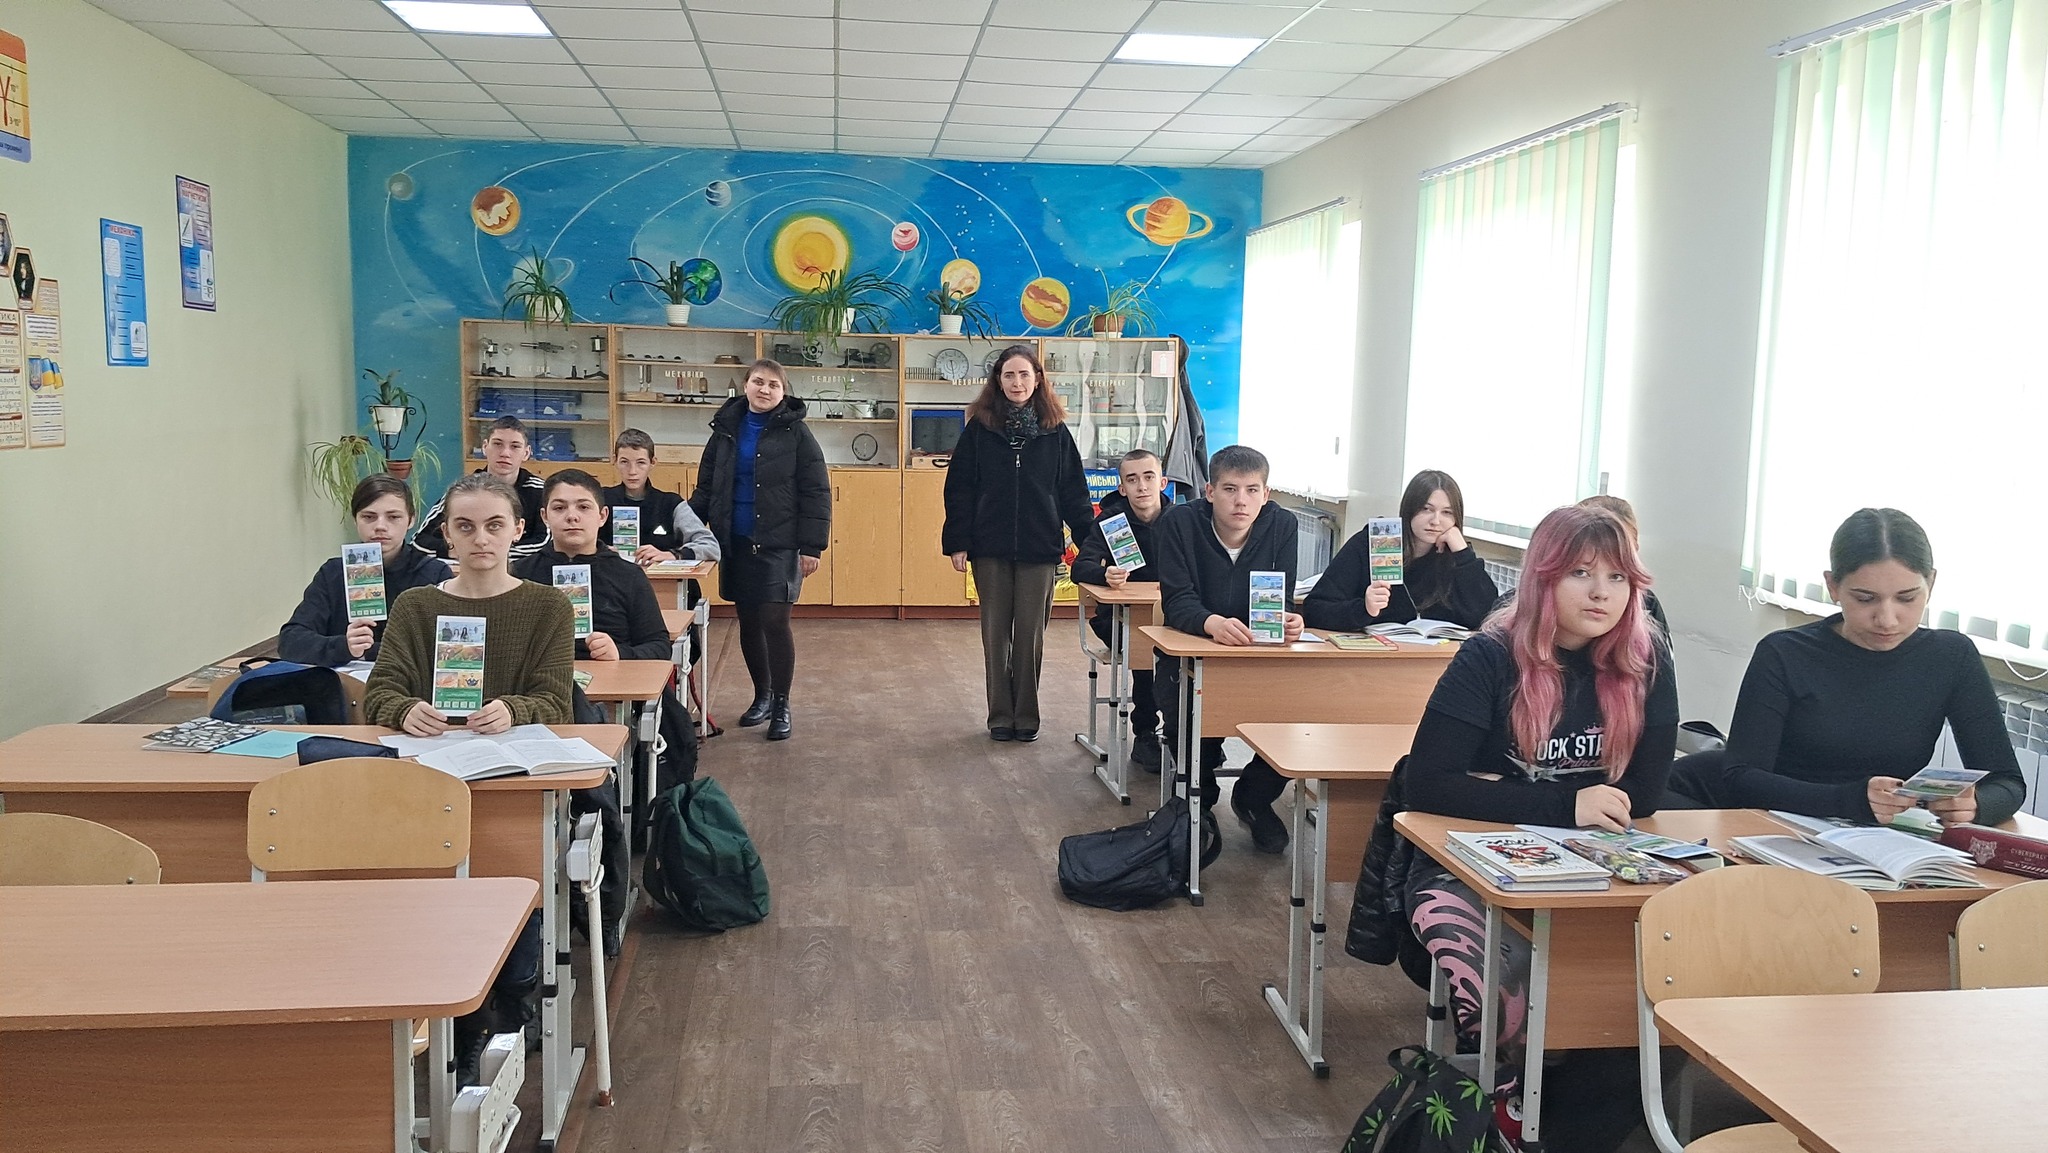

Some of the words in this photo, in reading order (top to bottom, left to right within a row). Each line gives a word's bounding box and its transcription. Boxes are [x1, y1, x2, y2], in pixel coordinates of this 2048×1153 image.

[0, 313, 17, 322] ИКА
[1086, 474, 1117, 487] РІЙСЬКА
[1536, 737, 1570, 761] OCK
[1574, 734, 1604, 757] STA
